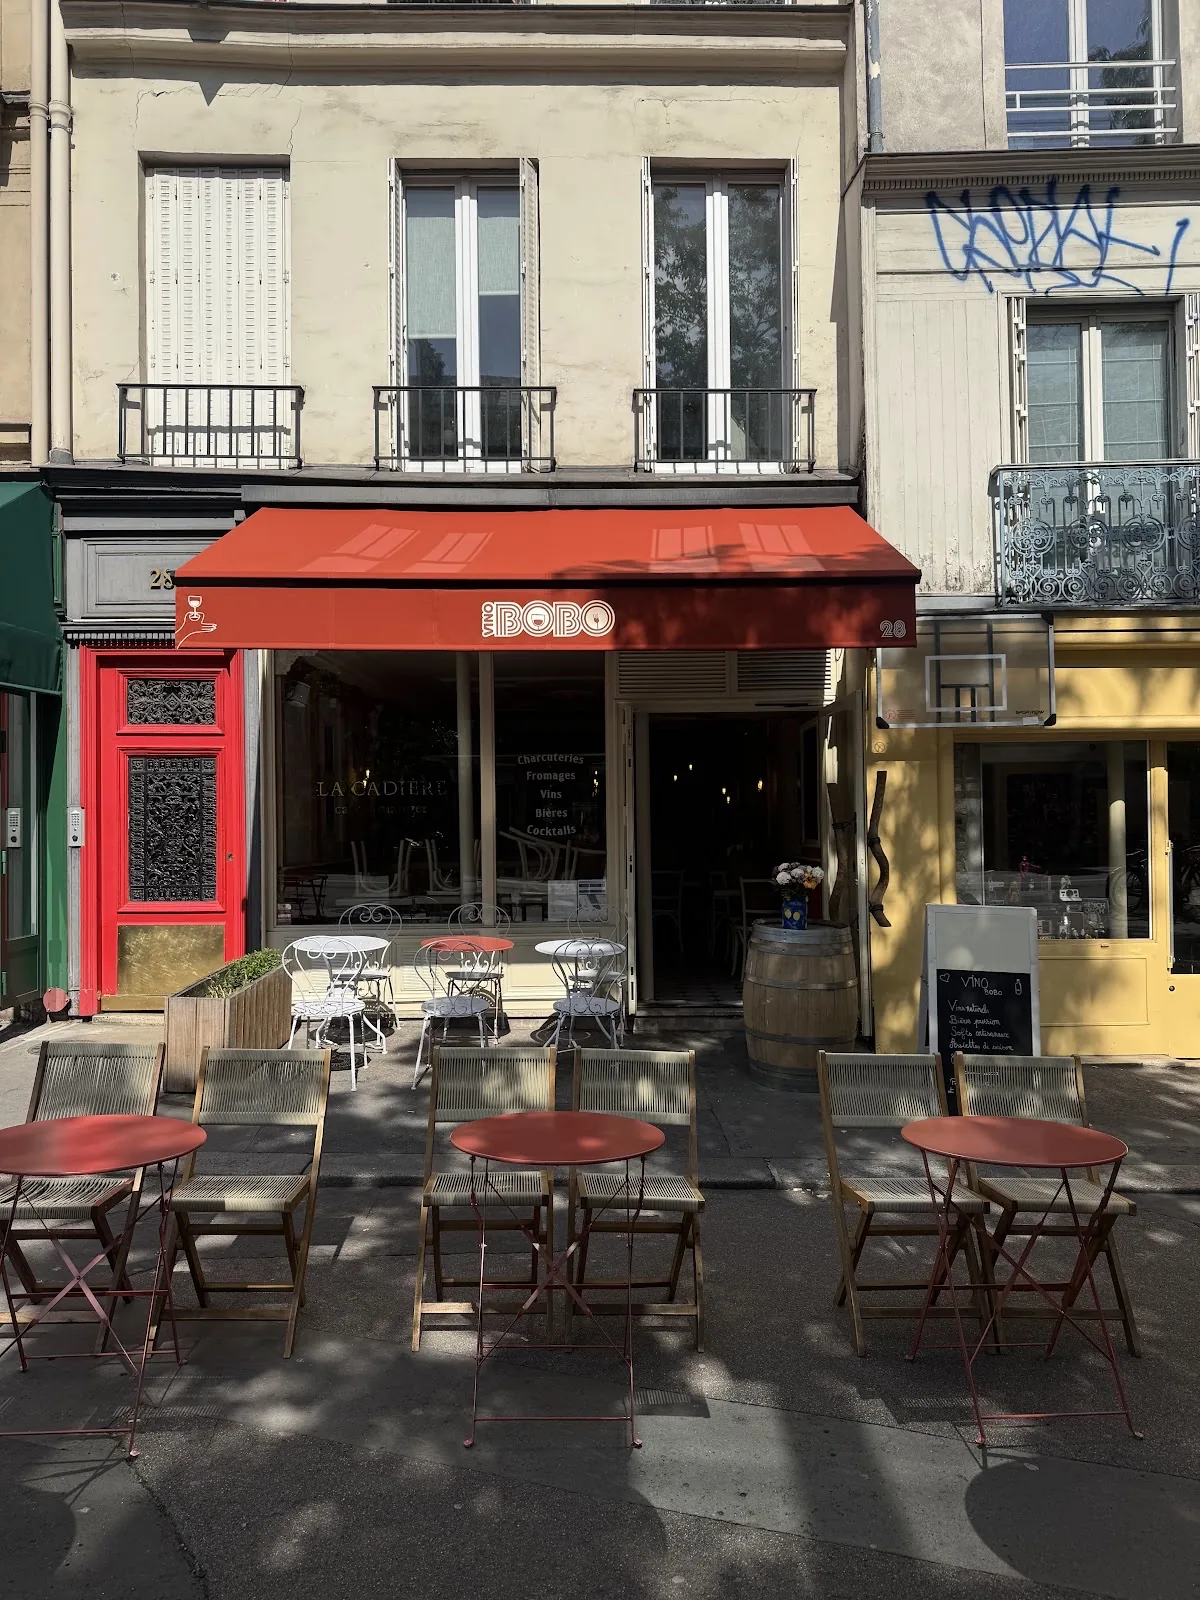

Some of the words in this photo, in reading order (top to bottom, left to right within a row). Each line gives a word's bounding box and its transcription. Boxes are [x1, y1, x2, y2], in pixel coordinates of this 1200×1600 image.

[150, 568, 174, 590] 28
[482, 602, 494, 637] VINO
[494, 600, 615, 637] BOBO
[880, 620, 906, 638] 28
[517, 753, 584, 765] Charcuteries
[526, 771, 576, 782] Fromages
[316, 781, 344, 797] LA
[540, 789, 562, 799] Vins
[535, 808, 568, 818] Bières
[526, 824, 577, 836] Cocktails
[961, 975, 988, 989] VINO
[949, 1014, 971, 1025] Bières
[973, 1018, 1001, 1028] pression
[951, 1026, 972, 1040] Softs
[975, 1029, 1009, 1038] artisanaux
